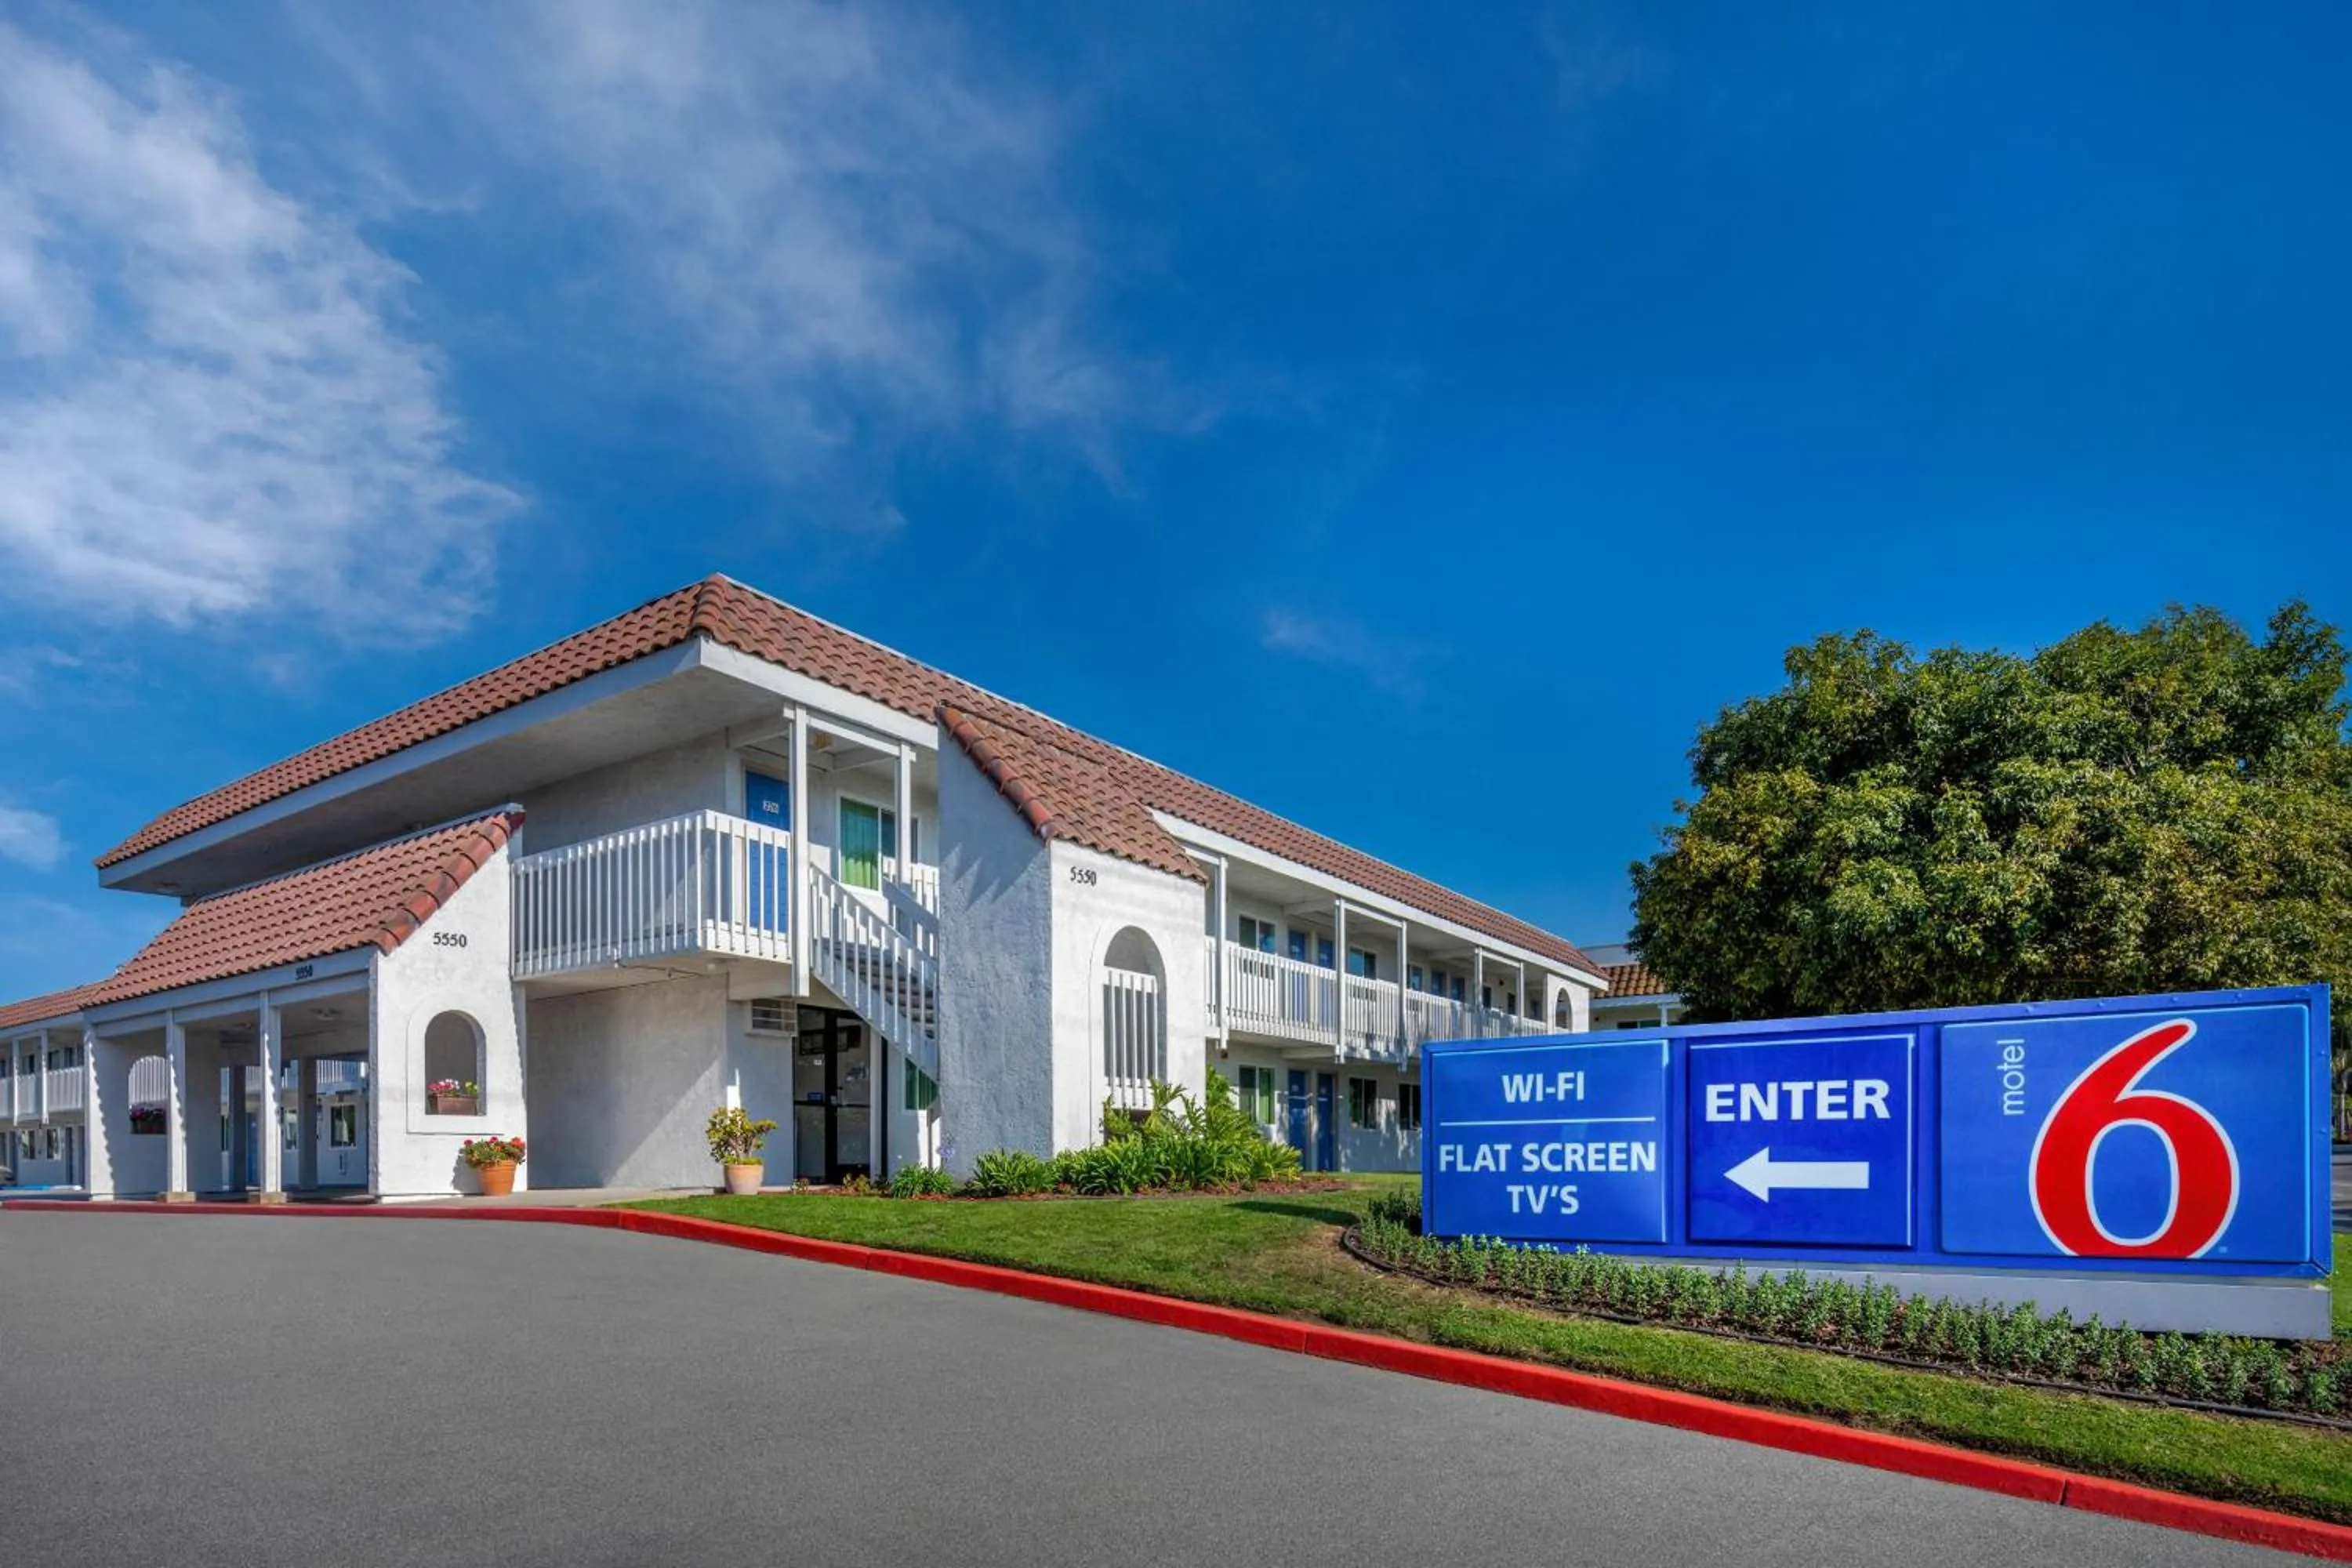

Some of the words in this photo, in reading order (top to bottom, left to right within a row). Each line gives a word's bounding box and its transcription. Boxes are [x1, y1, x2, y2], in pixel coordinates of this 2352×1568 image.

[1070, 866, 1096, 886] 5550
[433, 932, 467, 947] 5550
[1501, 1071, 1584, 1103] WI-FI
[1705, 1079, 1891, 1122] ENTER
[1996, 1039, 2025, 1116] motel
[2028, 1018, 2240, 1258] 6
[1439, 1143, 1512, 1172] FLAT
[1522, 1142, 1656, 1172] SCREEN
[1506, 1185, 1579, 1214] TV'S
